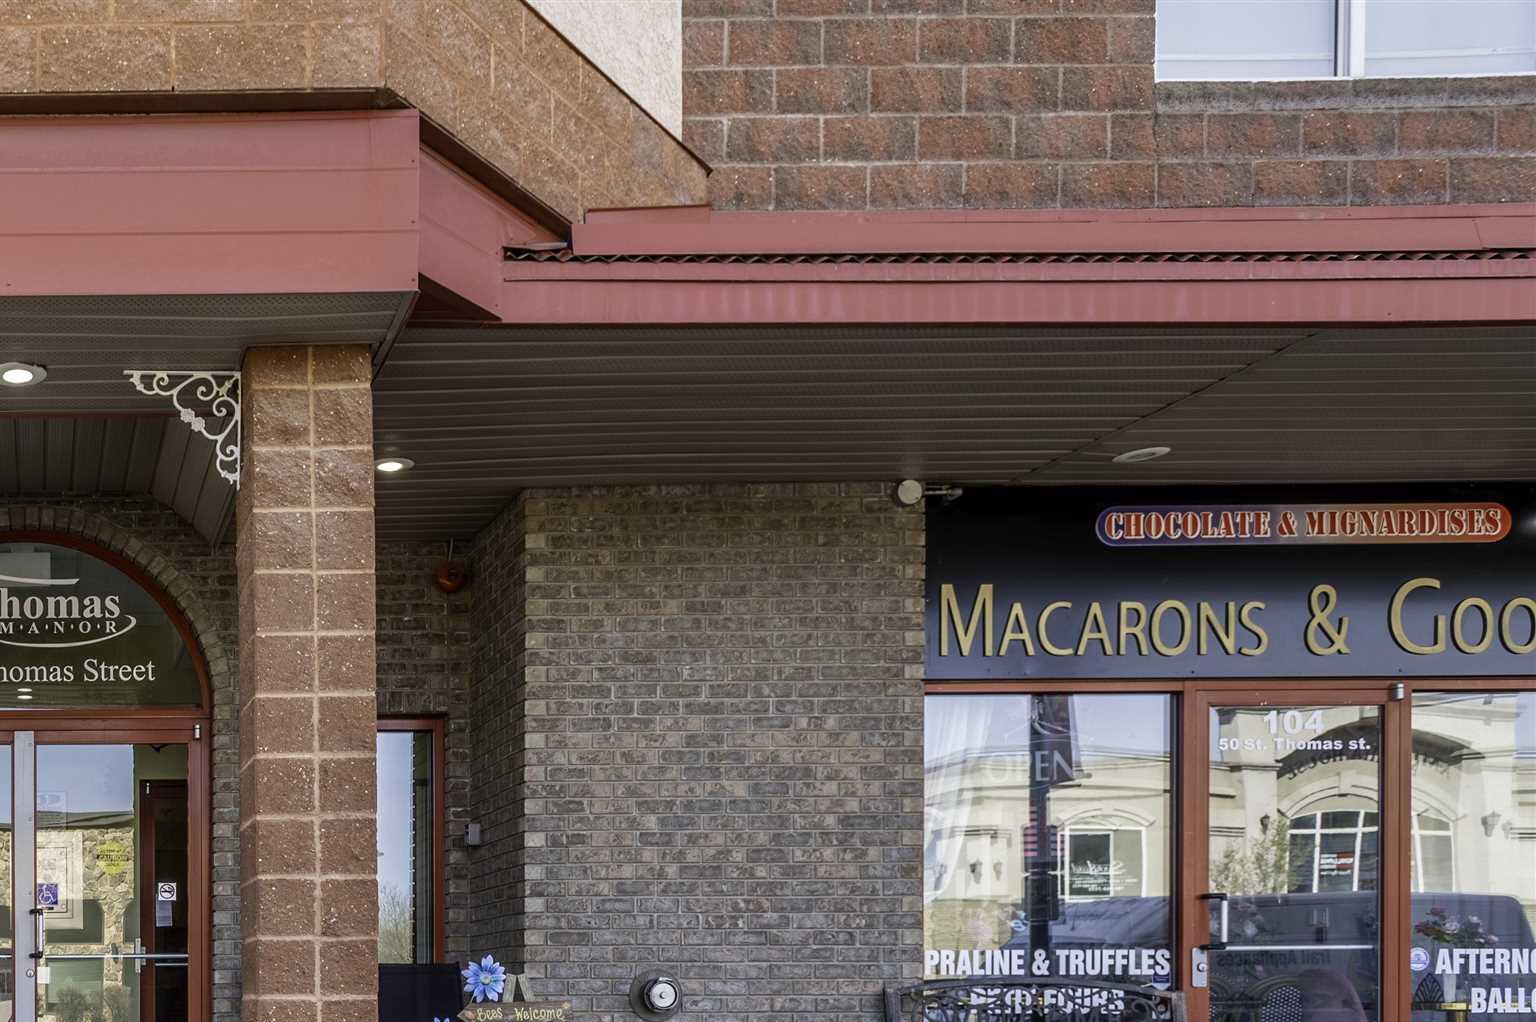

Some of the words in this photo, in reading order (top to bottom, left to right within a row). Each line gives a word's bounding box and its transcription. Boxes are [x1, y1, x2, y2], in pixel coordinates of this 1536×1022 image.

[1104, 509, 1272, 540] CHOCOLATE
[1276, 510, 1299, 538] &
[1304, 507, 1503, 538] MIGNARDISES
[938, 583, 1270, 658] MACARONS
[1304, 584, 1352, 657] &
[83, 658, 156, 683] Street
[1264, 711, 1326, 736] 104
[1219, 738, 1240, 751] 50
[1245, 738, 1268, 751] St.
[1274, 737, 1343, 751] Thomas
[1348, 738, 1371, 751] st.
[923, 949, 1025, 976] PRALINE
[1031, 948, 1050, 976] &
[1055, 949, 1171, 976] TRUFFLES
[477, 1007, 504, 1022] Bees
[514, 1007, 565, 1021] Welcome
